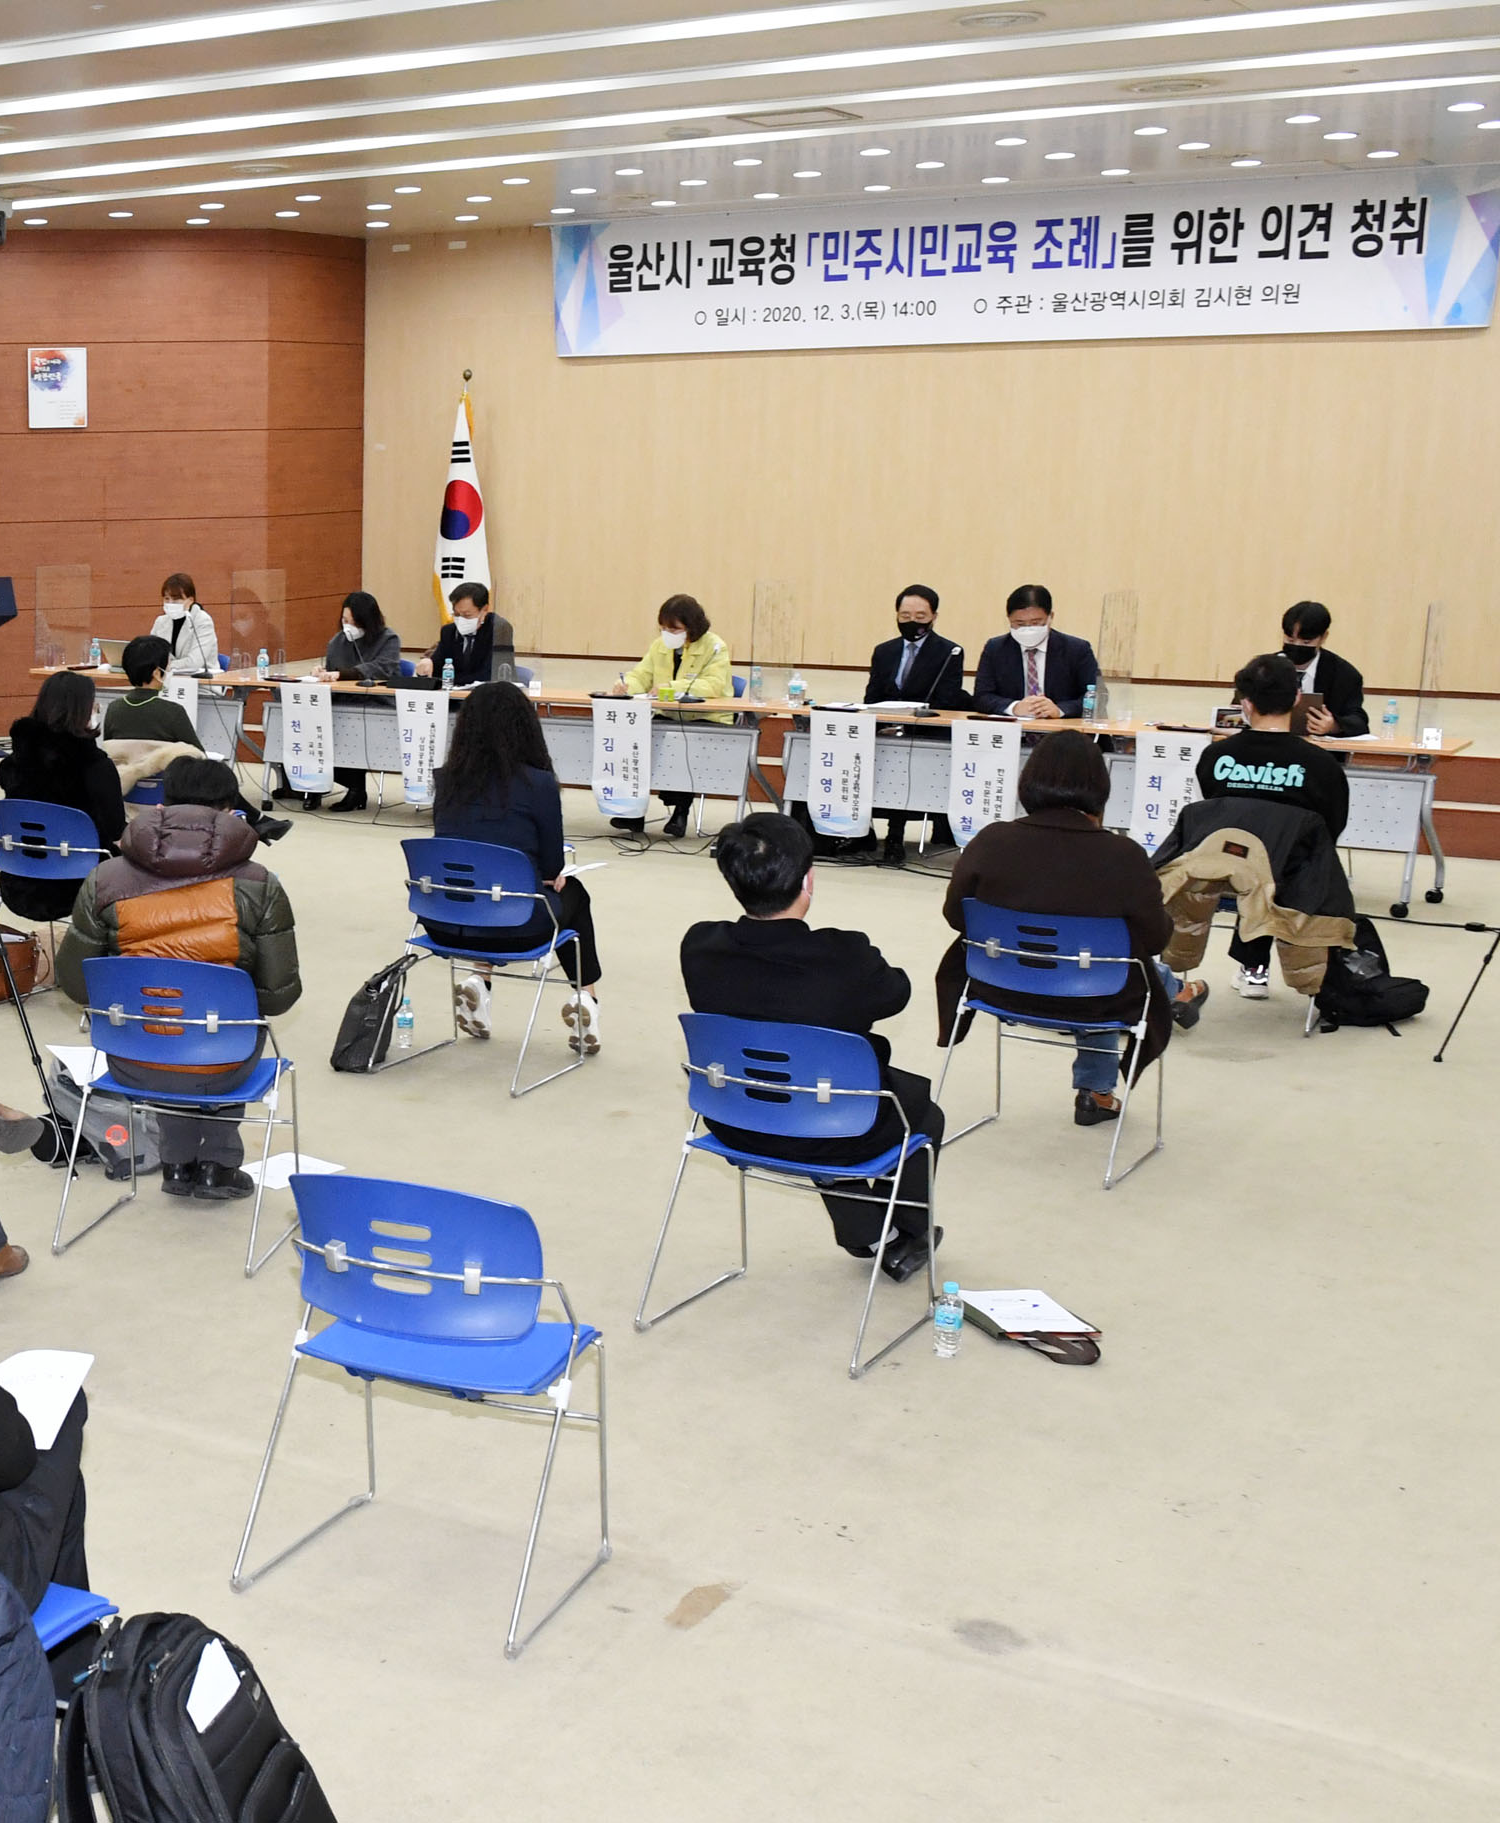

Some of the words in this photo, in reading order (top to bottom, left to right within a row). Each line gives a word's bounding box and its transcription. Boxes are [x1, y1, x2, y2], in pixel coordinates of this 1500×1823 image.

[1032, 213, 1154, 269] 조례」를
[1170, 206, 1245, 265] 위한
[1258, 202, 1333, 260] 의견
[1350, 196, 1428, 258] 청취
[715, 306, 746, 327] 일시
[763, 305, 806, 323] 2020.
[813, 304, 834, 322] 12.
[840, 299, 886, 321] 3.(목)
[892, 300, 937, 317] 14:00
[996, 295, 1032, 315] 주관
[1051, 287, 1185, 313] 울산광역시의회
[1194, 284, 1252, 307] 김시현
[1261, 282, 1301, 305] 의원
[291, 719, 302, 778] 천주미
[605, 710, 637, 725] 좌장
[602, 737, 615, 801] 김시현
[819, 752, 834, 819] 김영길
[959, 762, 976, 832] 신영철
[1142, 775, 1162, 847] 최인호
